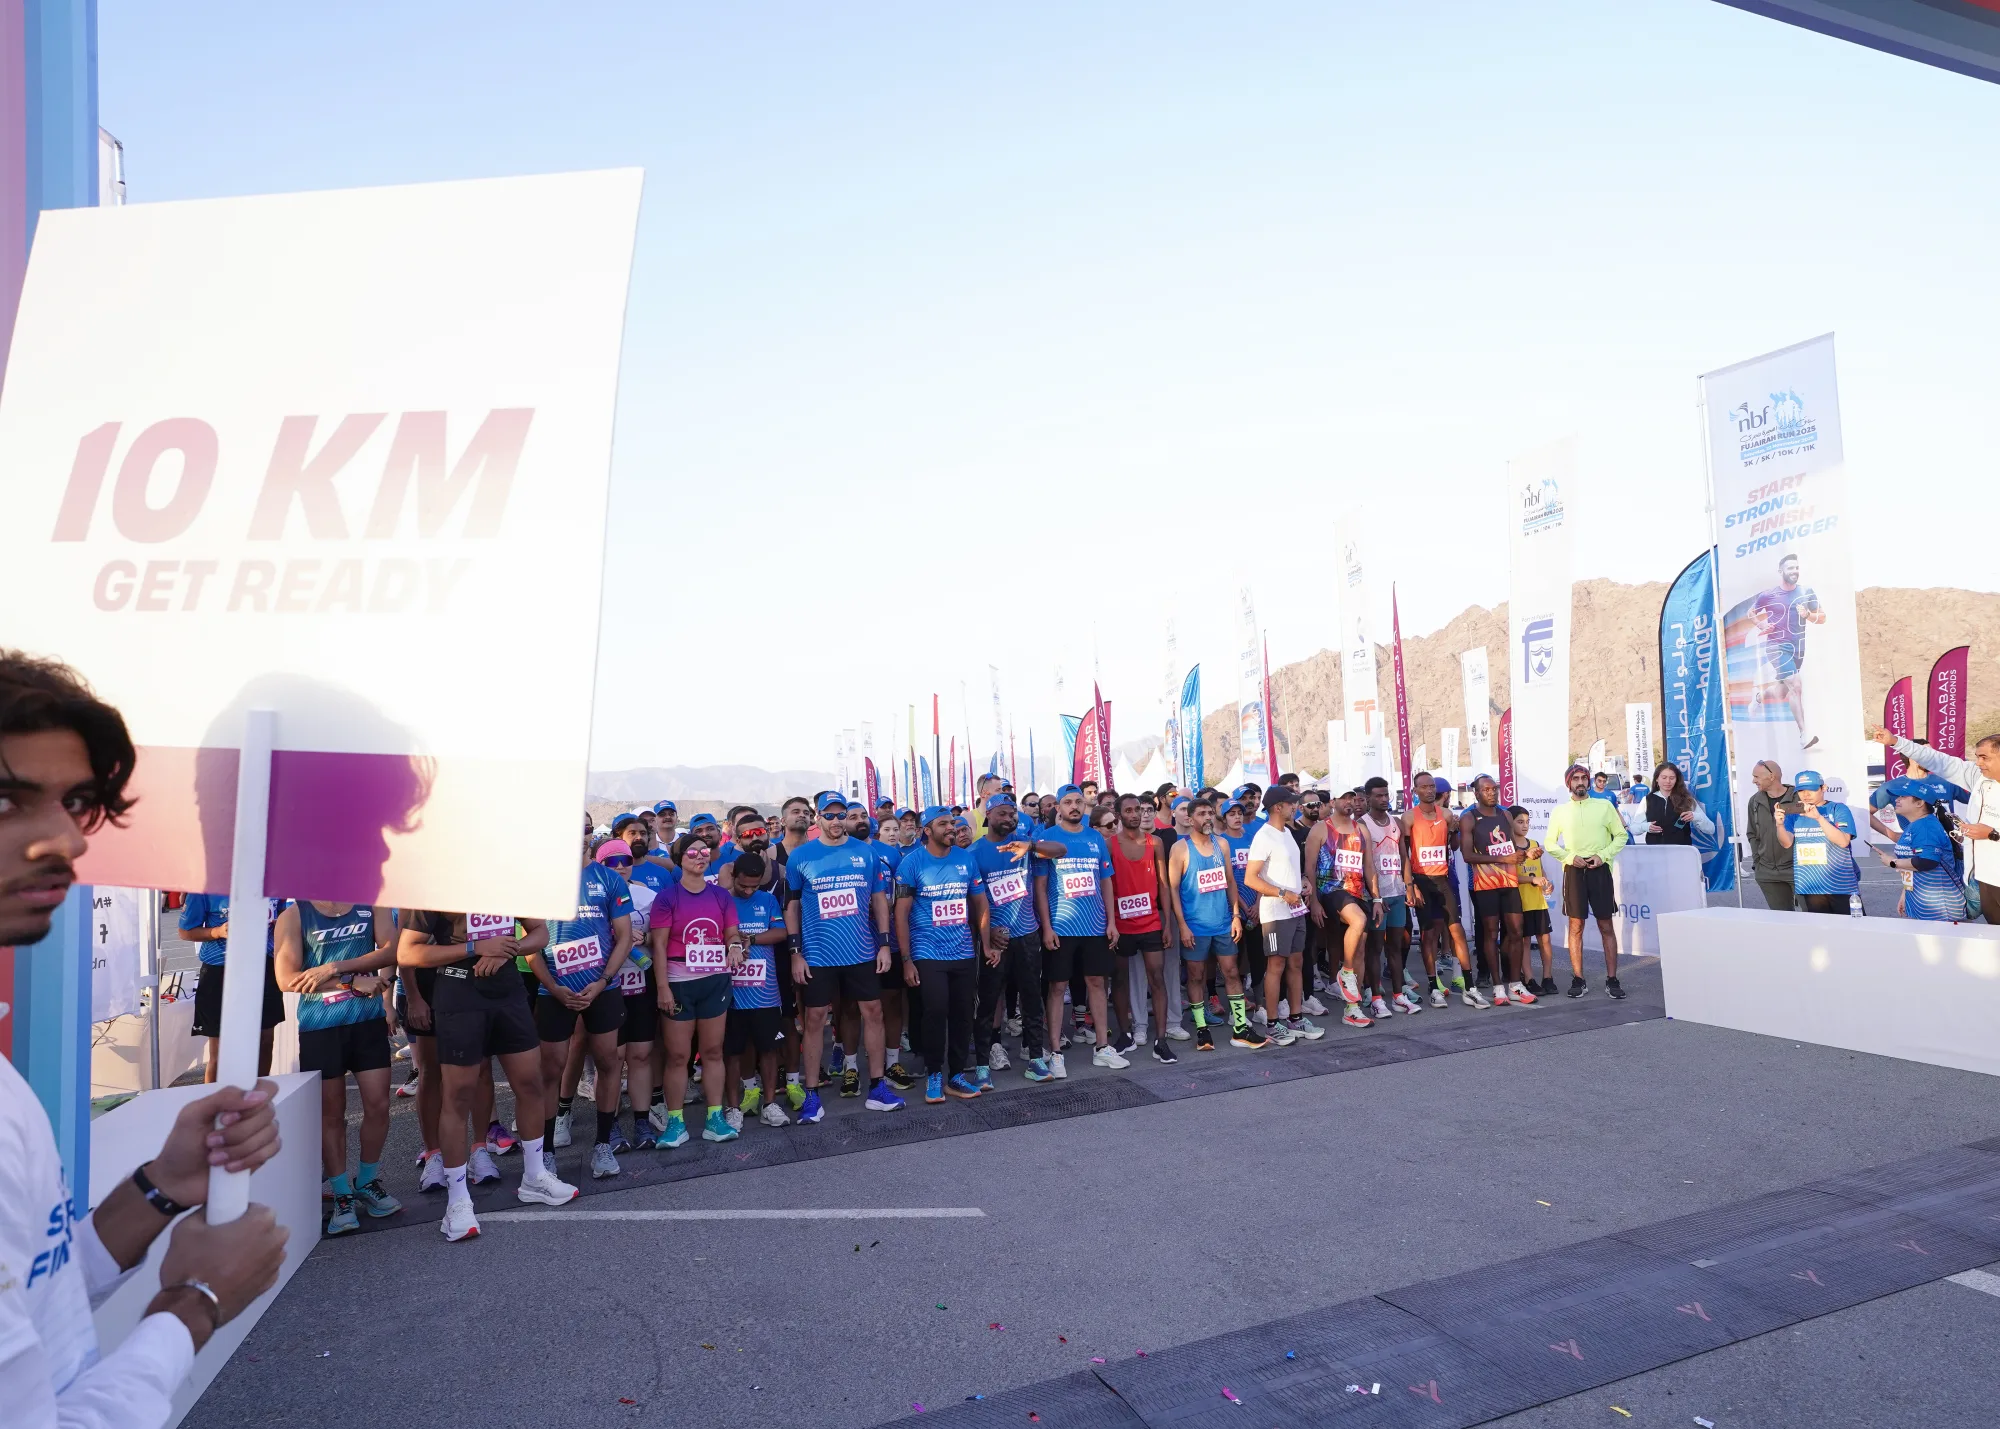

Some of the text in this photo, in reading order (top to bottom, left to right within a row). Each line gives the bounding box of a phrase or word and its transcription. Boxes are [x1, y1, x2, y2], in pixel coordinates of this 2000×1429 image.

[1739, 406, 1770, 432] nbf
[1741, 436, 1776, 451] FUJAIRAH
[1778, 430, 1795, 440] RUN
[1796, 426, 1816, 435] 2025
[1762, 454, 1770, 462] 5K
[1802, 444, 1815, 452] 11K
[51, 407, 536, 543] 10 KM
[1747, 472, 1806, 505] START
[1524, 489, 1541, 508] nbf
[1725, 492, 1802, 528] STRONG,
[1750, 506, 1815, 538] FINISH
[1735, 515, 1838, 558] STRONGER
[93, 556, 473, 614] GET READY
[1938, 670, 1949, 750] MALABAR
[1892, 696, 1901, 755] MLABAR
[1673, 682, 1694, 788] للصراف
[1948, 724, 1956, 748] GOLD
[1083, 724, 1093, 781] ALABAR
[1238, 853, 1248, 862] 61
[1337, 854, 1360, 865] 6137
[1422, 850, 1442, 859] 6141
[1798, 848, 1822, 857] 168
[812, 876, 835, 884] START
[1066, 876, 1093, 889] 6039
[1200, 871, 1223, 884] 6208
[993, 879, 1020, 896] 6161
[822, 893, 854, 909] 6000
[935, 903, 964, 917] 6155
[1121, 897, 1148, 910] 6268
[312, 923, 368, 941] T100
[557, 942, 598, 963] 6205
[688, 950, 723, 963] 6125
[620, 971, 642, 985] 121
[731, 964, 763, 976] 6267
